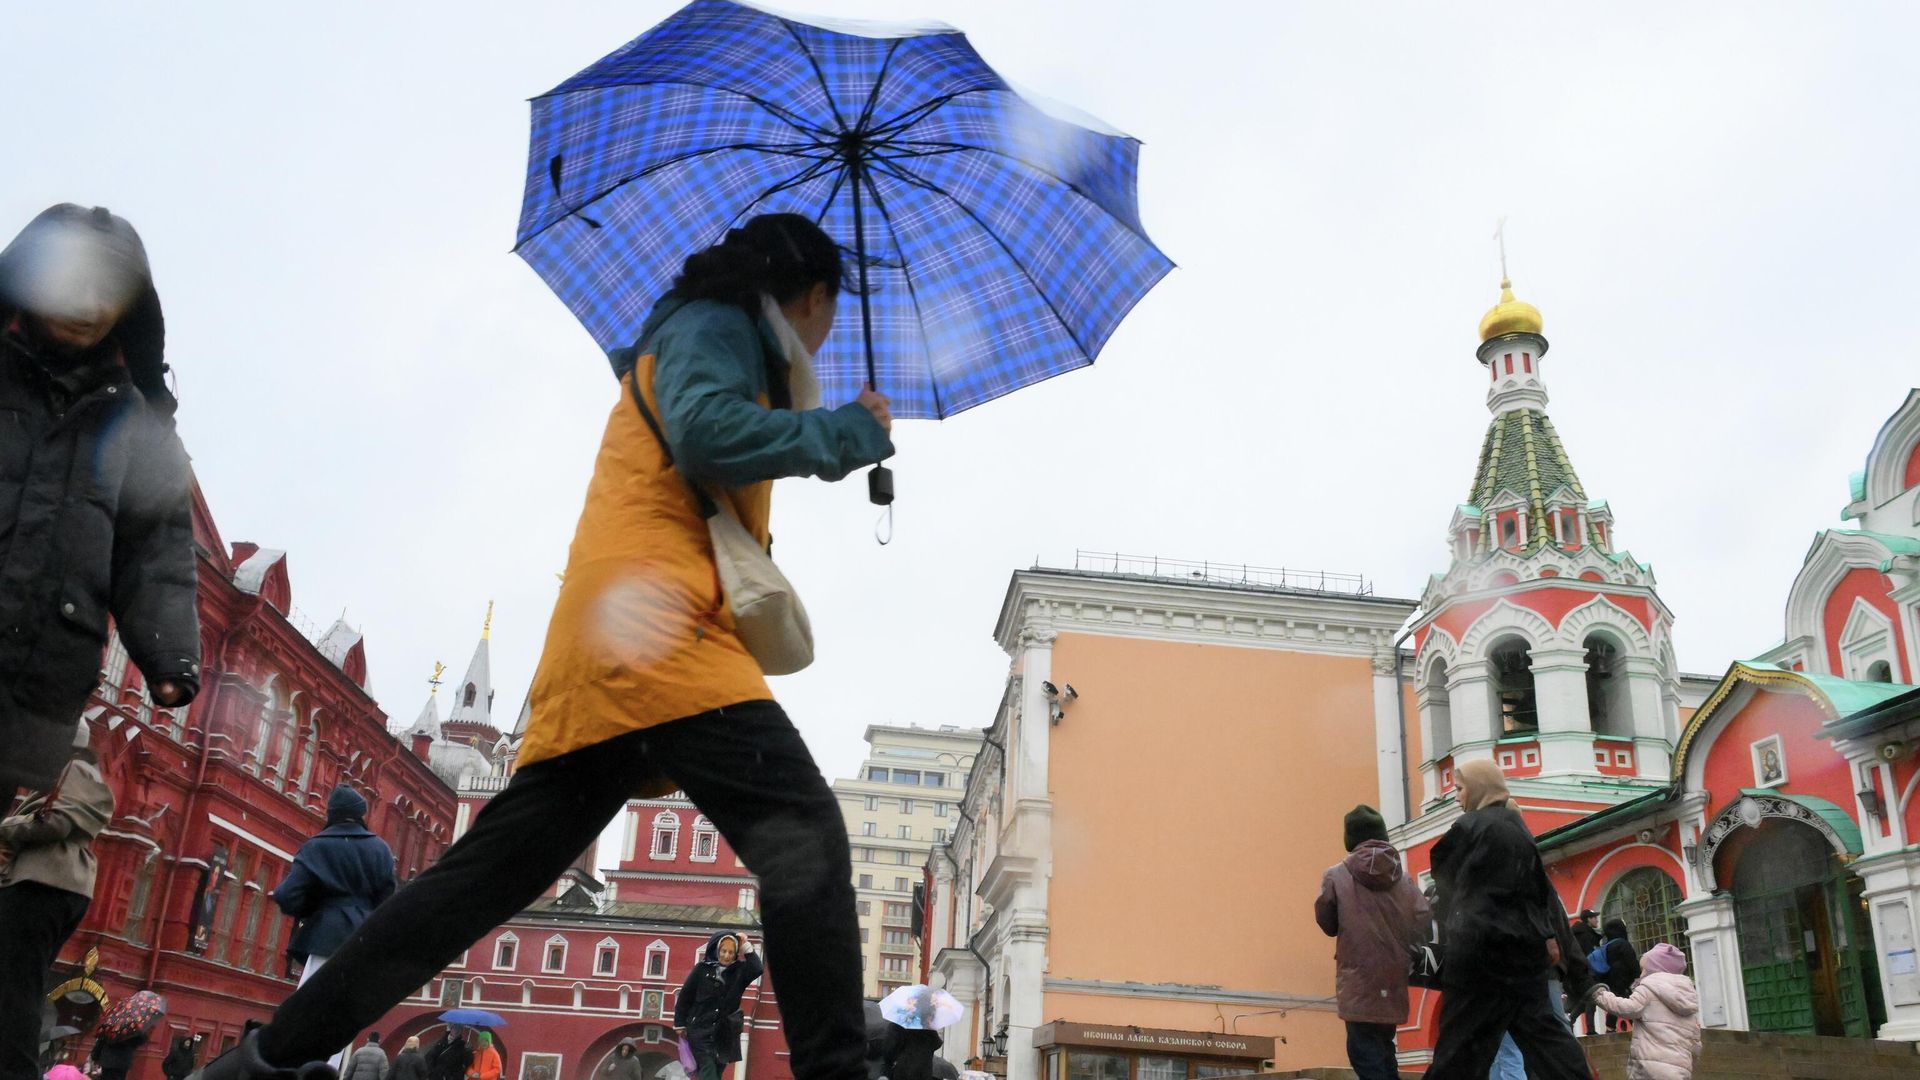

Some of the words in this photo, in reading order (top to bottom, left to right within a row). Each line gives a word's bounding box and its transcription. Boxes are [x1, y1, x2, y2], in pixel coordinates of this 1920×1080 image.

[1083, 1031, 1124, 1041] ИКОННАЯ
[1127, 1034, 1155, 1043] ЛАВКА
[1158, 1036, 1212, 1048] КАЗАНСКОГО
[1215, 1041, 1247, 1050] СОБОРА
